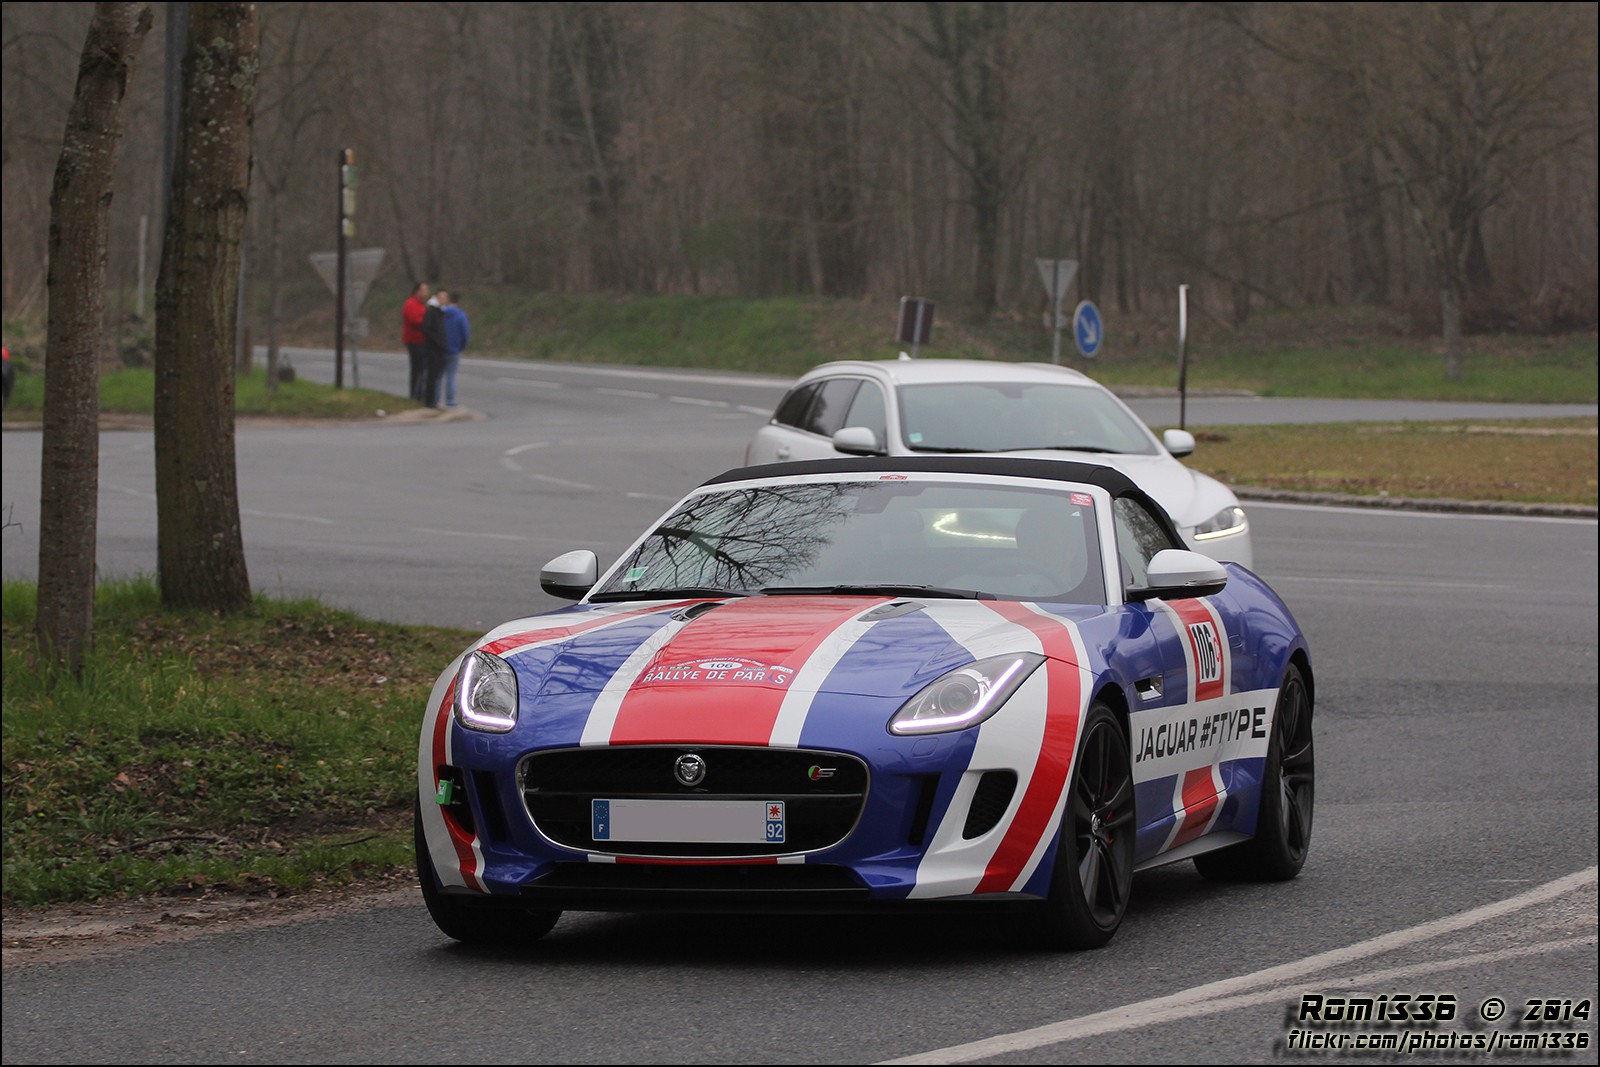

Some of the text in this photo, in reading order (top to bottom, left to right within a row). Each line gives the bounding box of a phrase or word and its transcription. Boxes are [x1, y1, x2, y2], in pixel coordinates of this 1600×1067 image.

[1191, 623, 1217, 680] 106
[642, 670, 702, 682] RALLYE
[705, 670, 729, 680] DE
[1135, 706, 1267, 763] JAGUAR #FTYPE
[598, 823, 605, 833] F
[767, 823, 783, 838] 92
